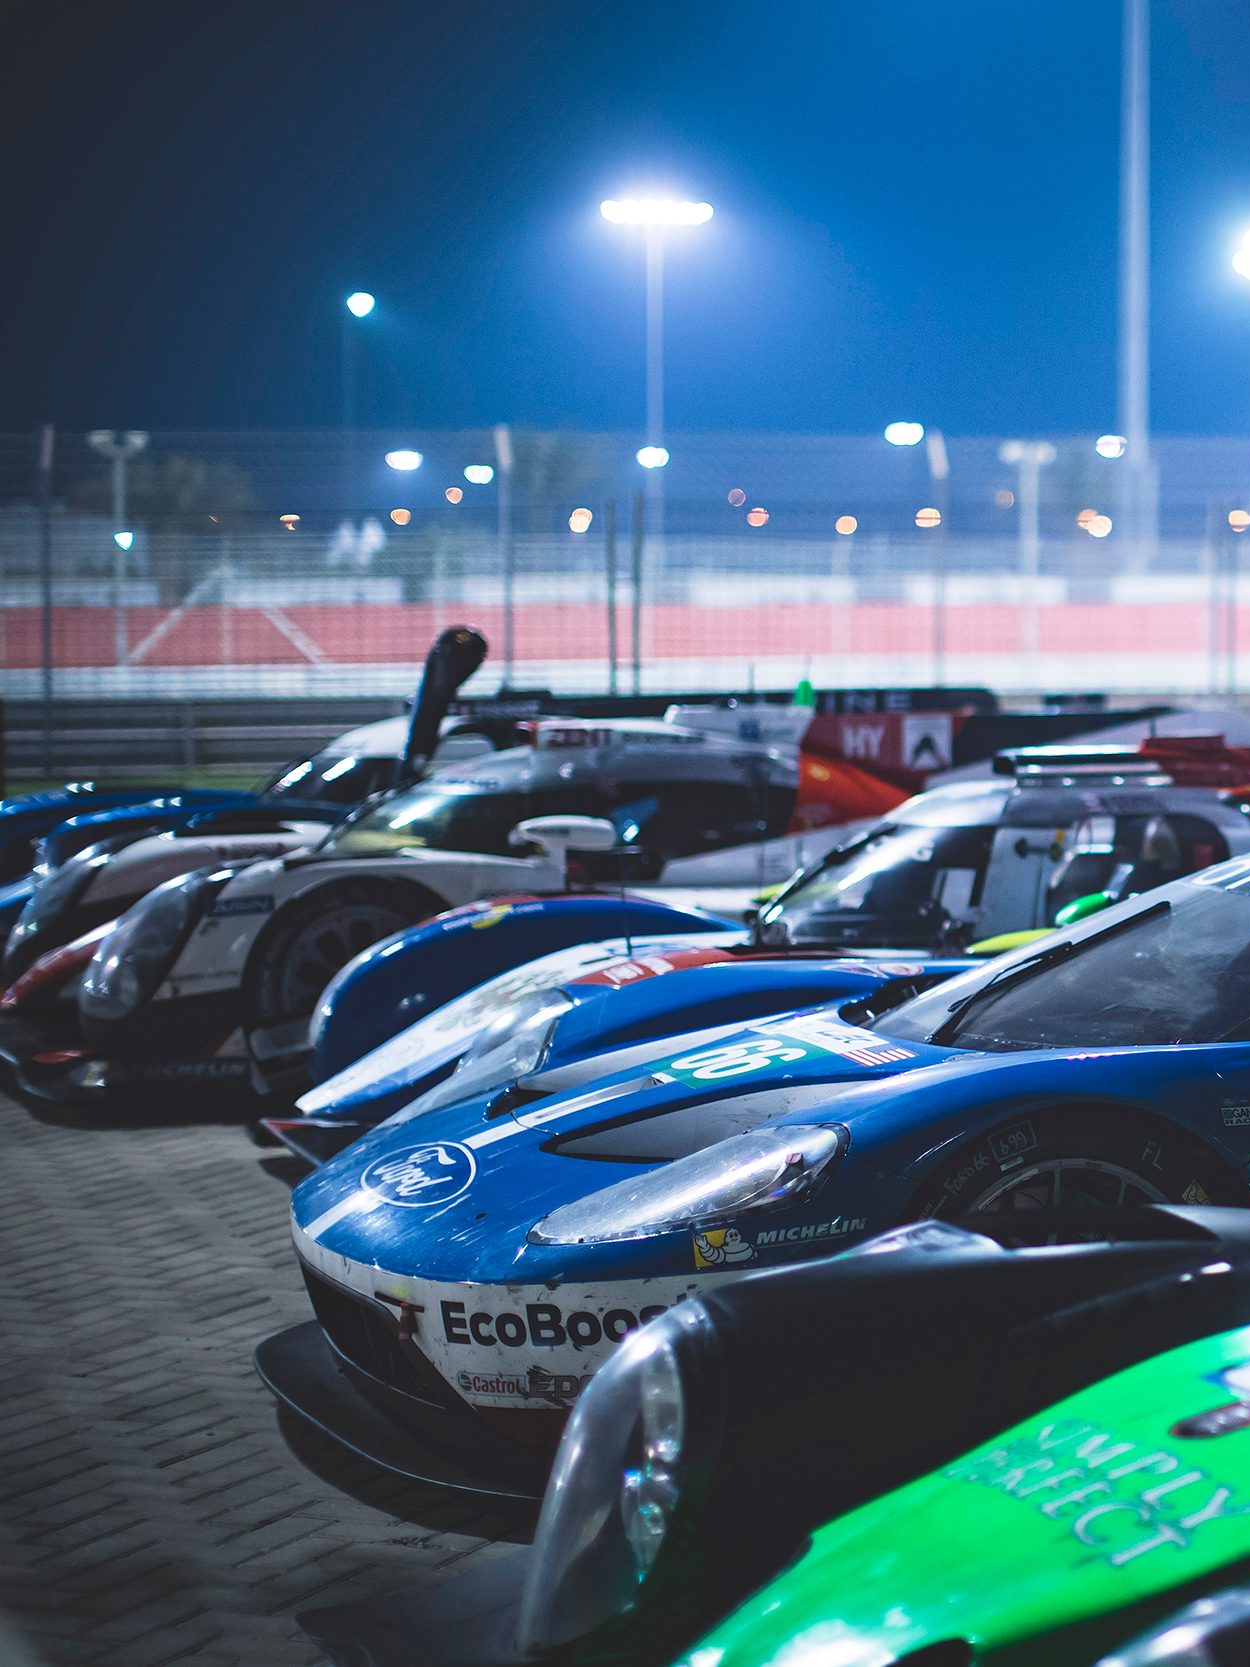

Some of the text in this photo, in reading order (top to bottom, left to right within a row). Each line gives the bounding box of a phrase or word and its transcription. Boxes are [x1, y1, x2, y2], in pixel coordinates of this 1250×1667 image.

[671, 1040, 807, 1079] 66
[373, 1147, 456, 1197] Ford
[1141, 1141, 1164, 1172] FL
[756, 1218, 867, 1245] MICHELIN
[472, 1376, 521, 1394] Castrol
